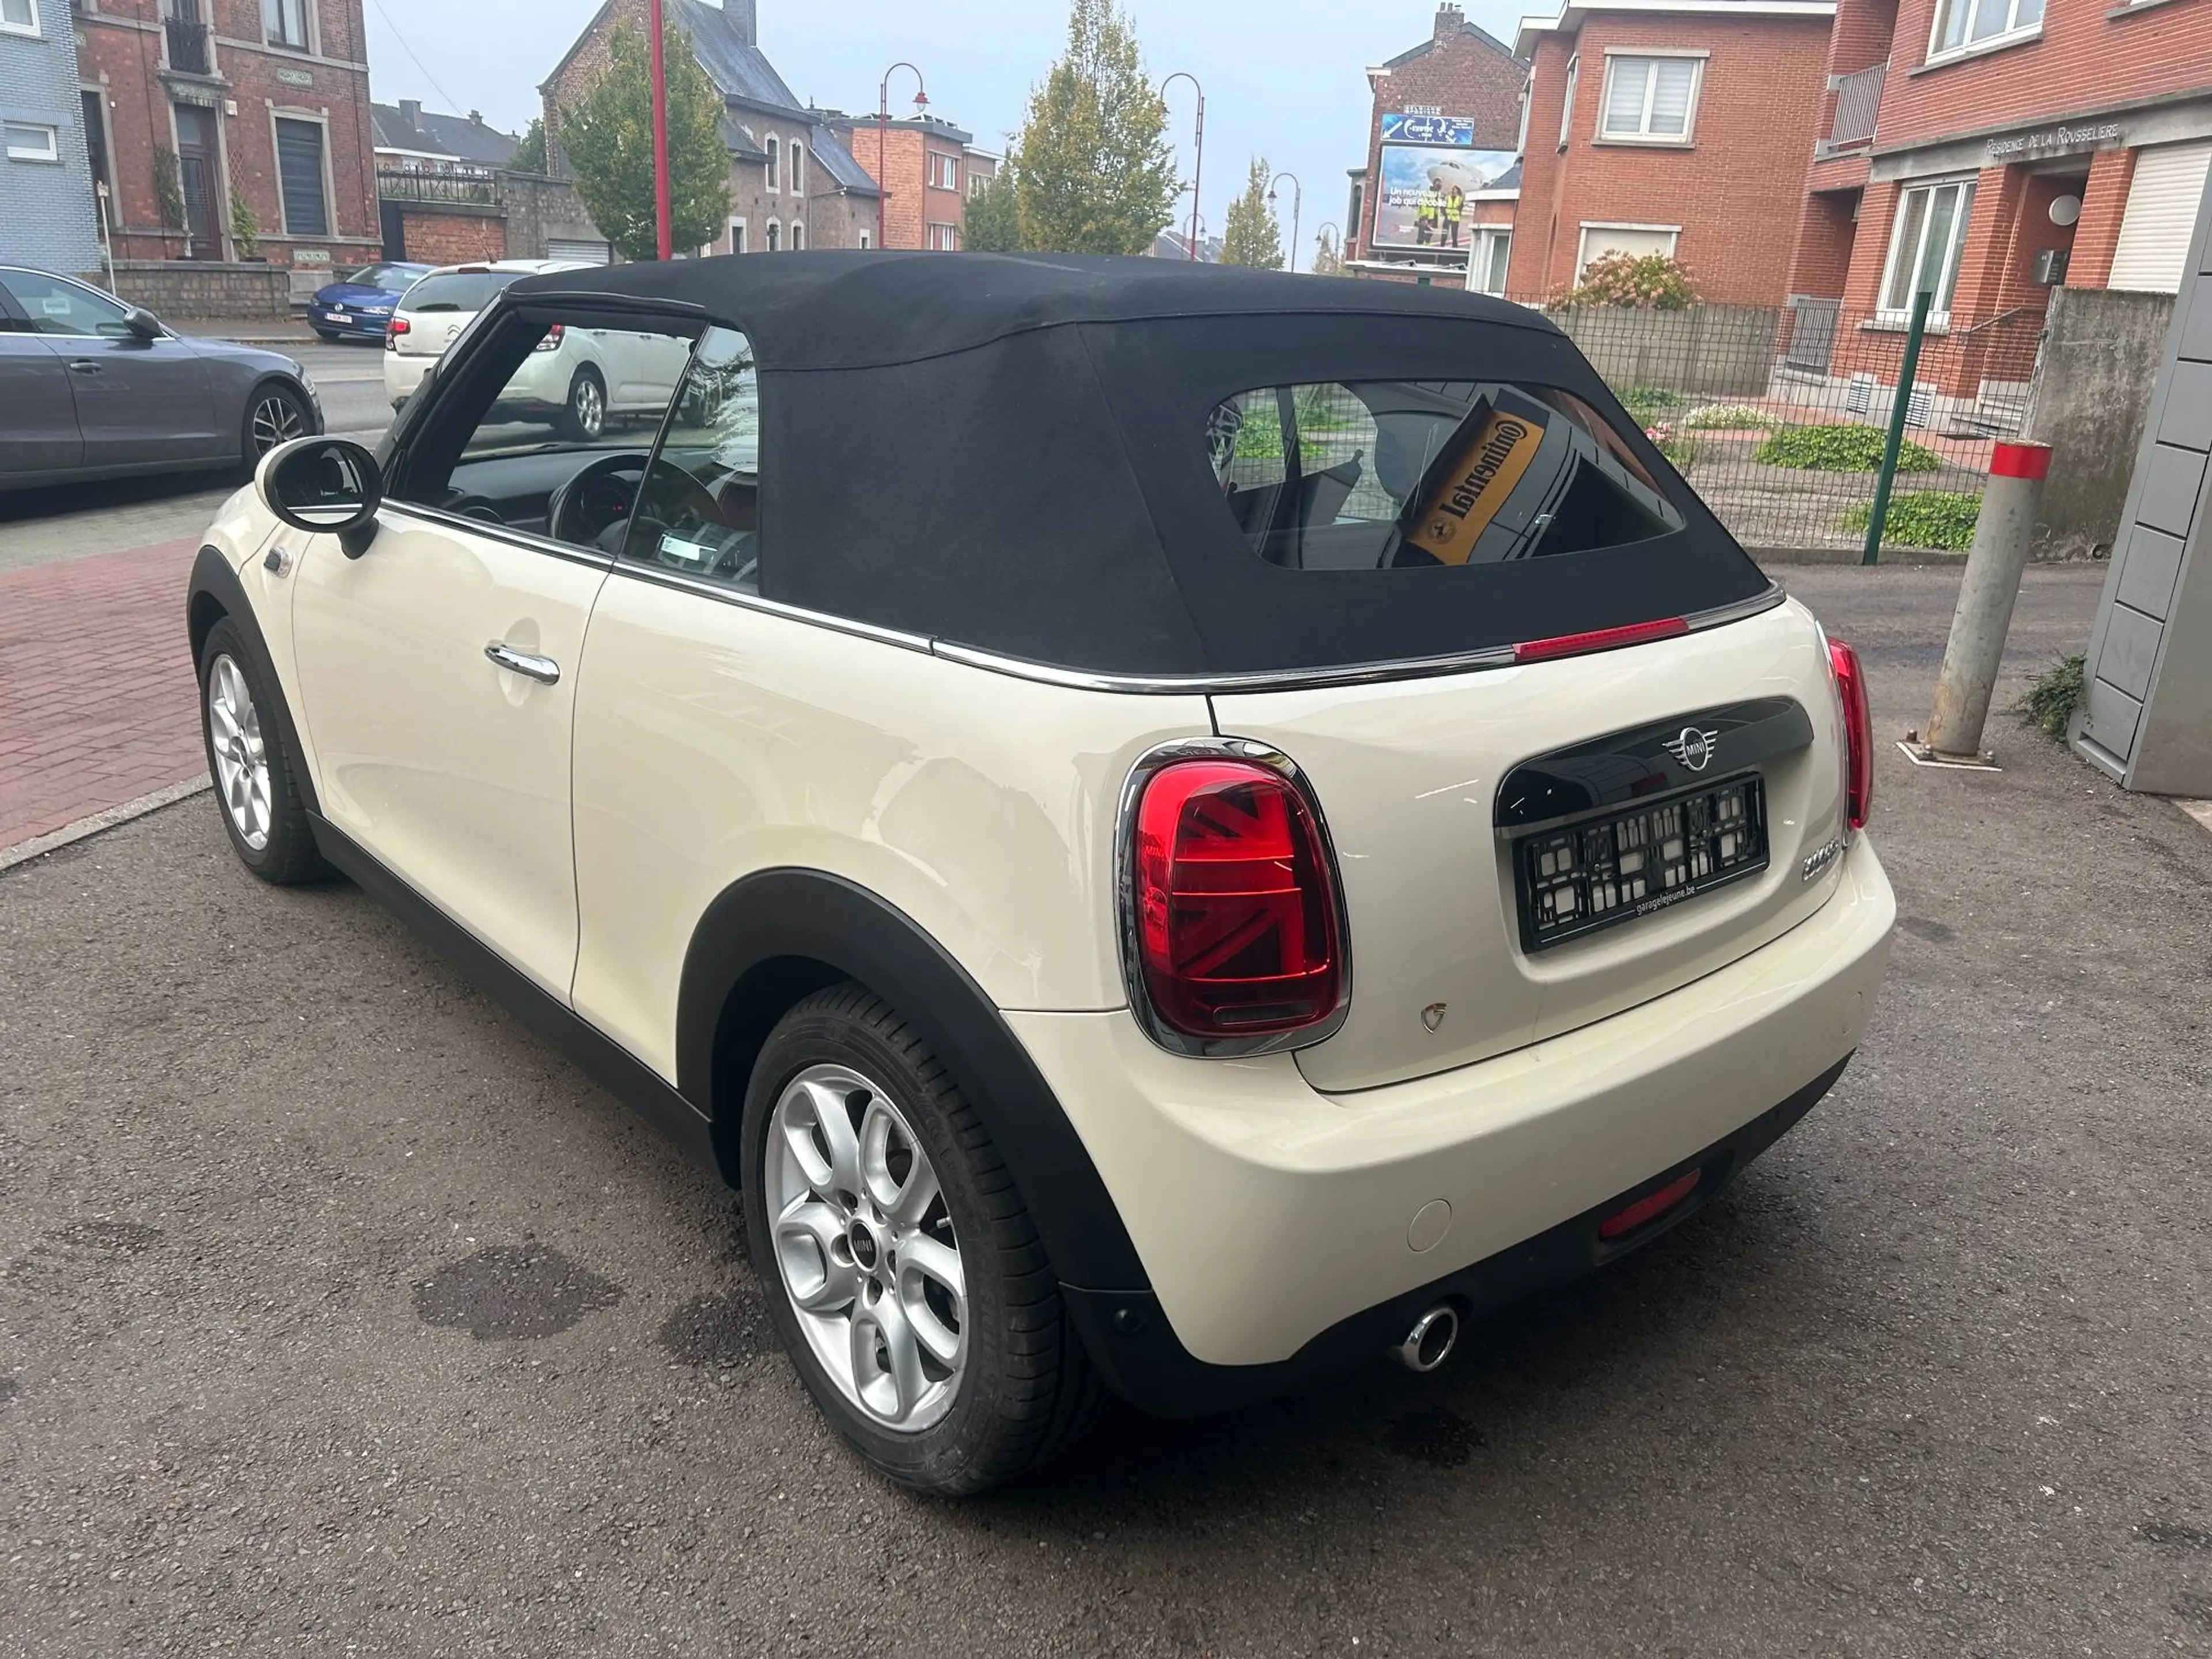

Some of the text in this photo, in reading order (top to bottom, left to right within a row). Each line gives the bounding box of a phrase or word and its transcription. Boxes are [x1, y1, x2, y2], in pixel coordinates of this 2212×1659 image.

[2029, 135, 2040, 148] DE
[2041, 133, 2052, 146] LA
[1390, 186, 1402, 195] Un
[1389, 195, 1402, 206] job
[1404, 196, 1416, 206] qui
[1686, 741, 1706, 756] MINI
[1637, 885, 1695, 915] garagelejeune.be
[854, 1239, 873, 1252] MINI
